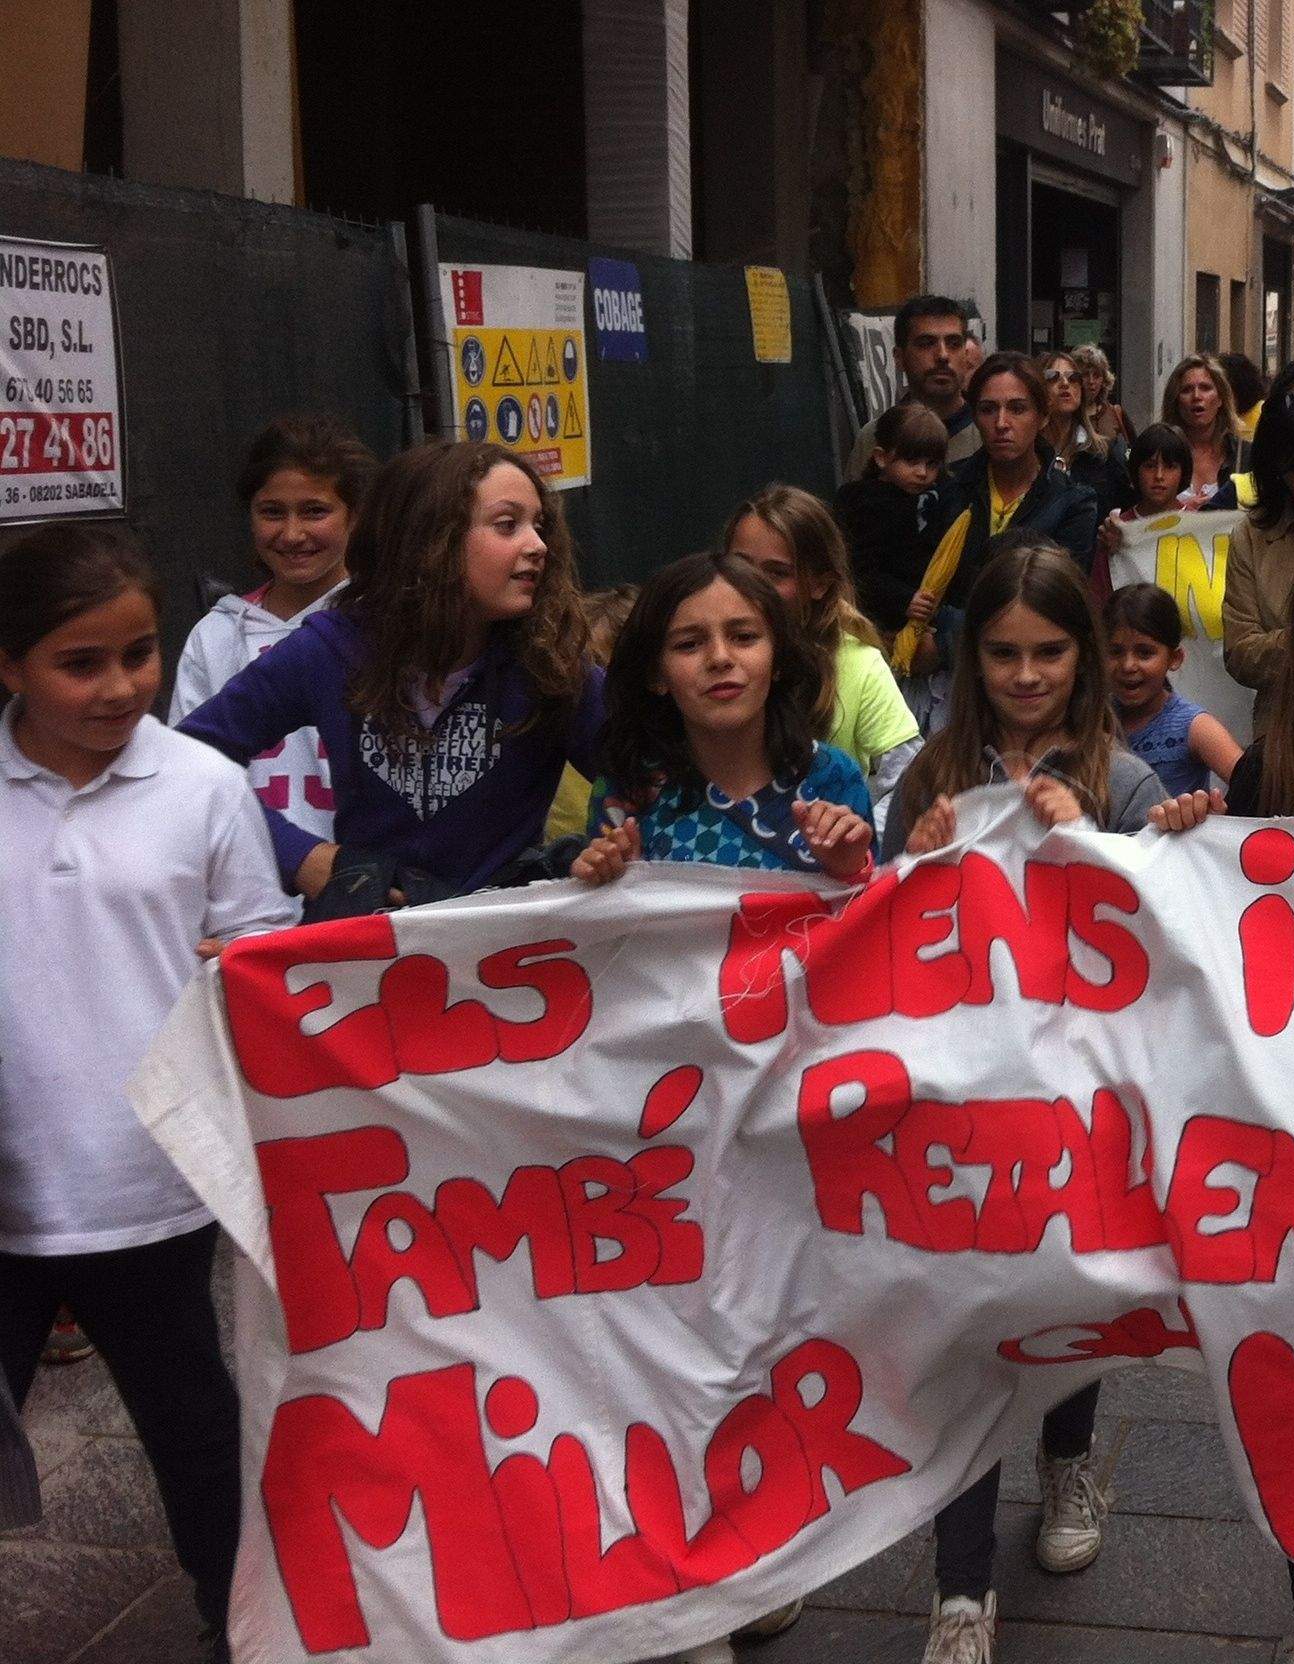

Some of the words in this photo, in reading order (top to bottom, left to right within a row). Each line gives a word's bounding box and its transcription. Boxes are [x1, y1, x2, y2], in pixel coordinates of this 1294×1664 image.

[594, 287, 645, 334] COBAGE
[9, 315, 55, 360] SBD,
[61, 318, 93, 353] S.L.
[58, 378, 75, 403] 56
[77, 379, 94, 404] 65
[82, 417, 111, 468] 86
[29, 484, 62, 502] 08202
[221, 915, 593, 1097] ELS
[254, 1064, 705, 1354] TAMBÉ
